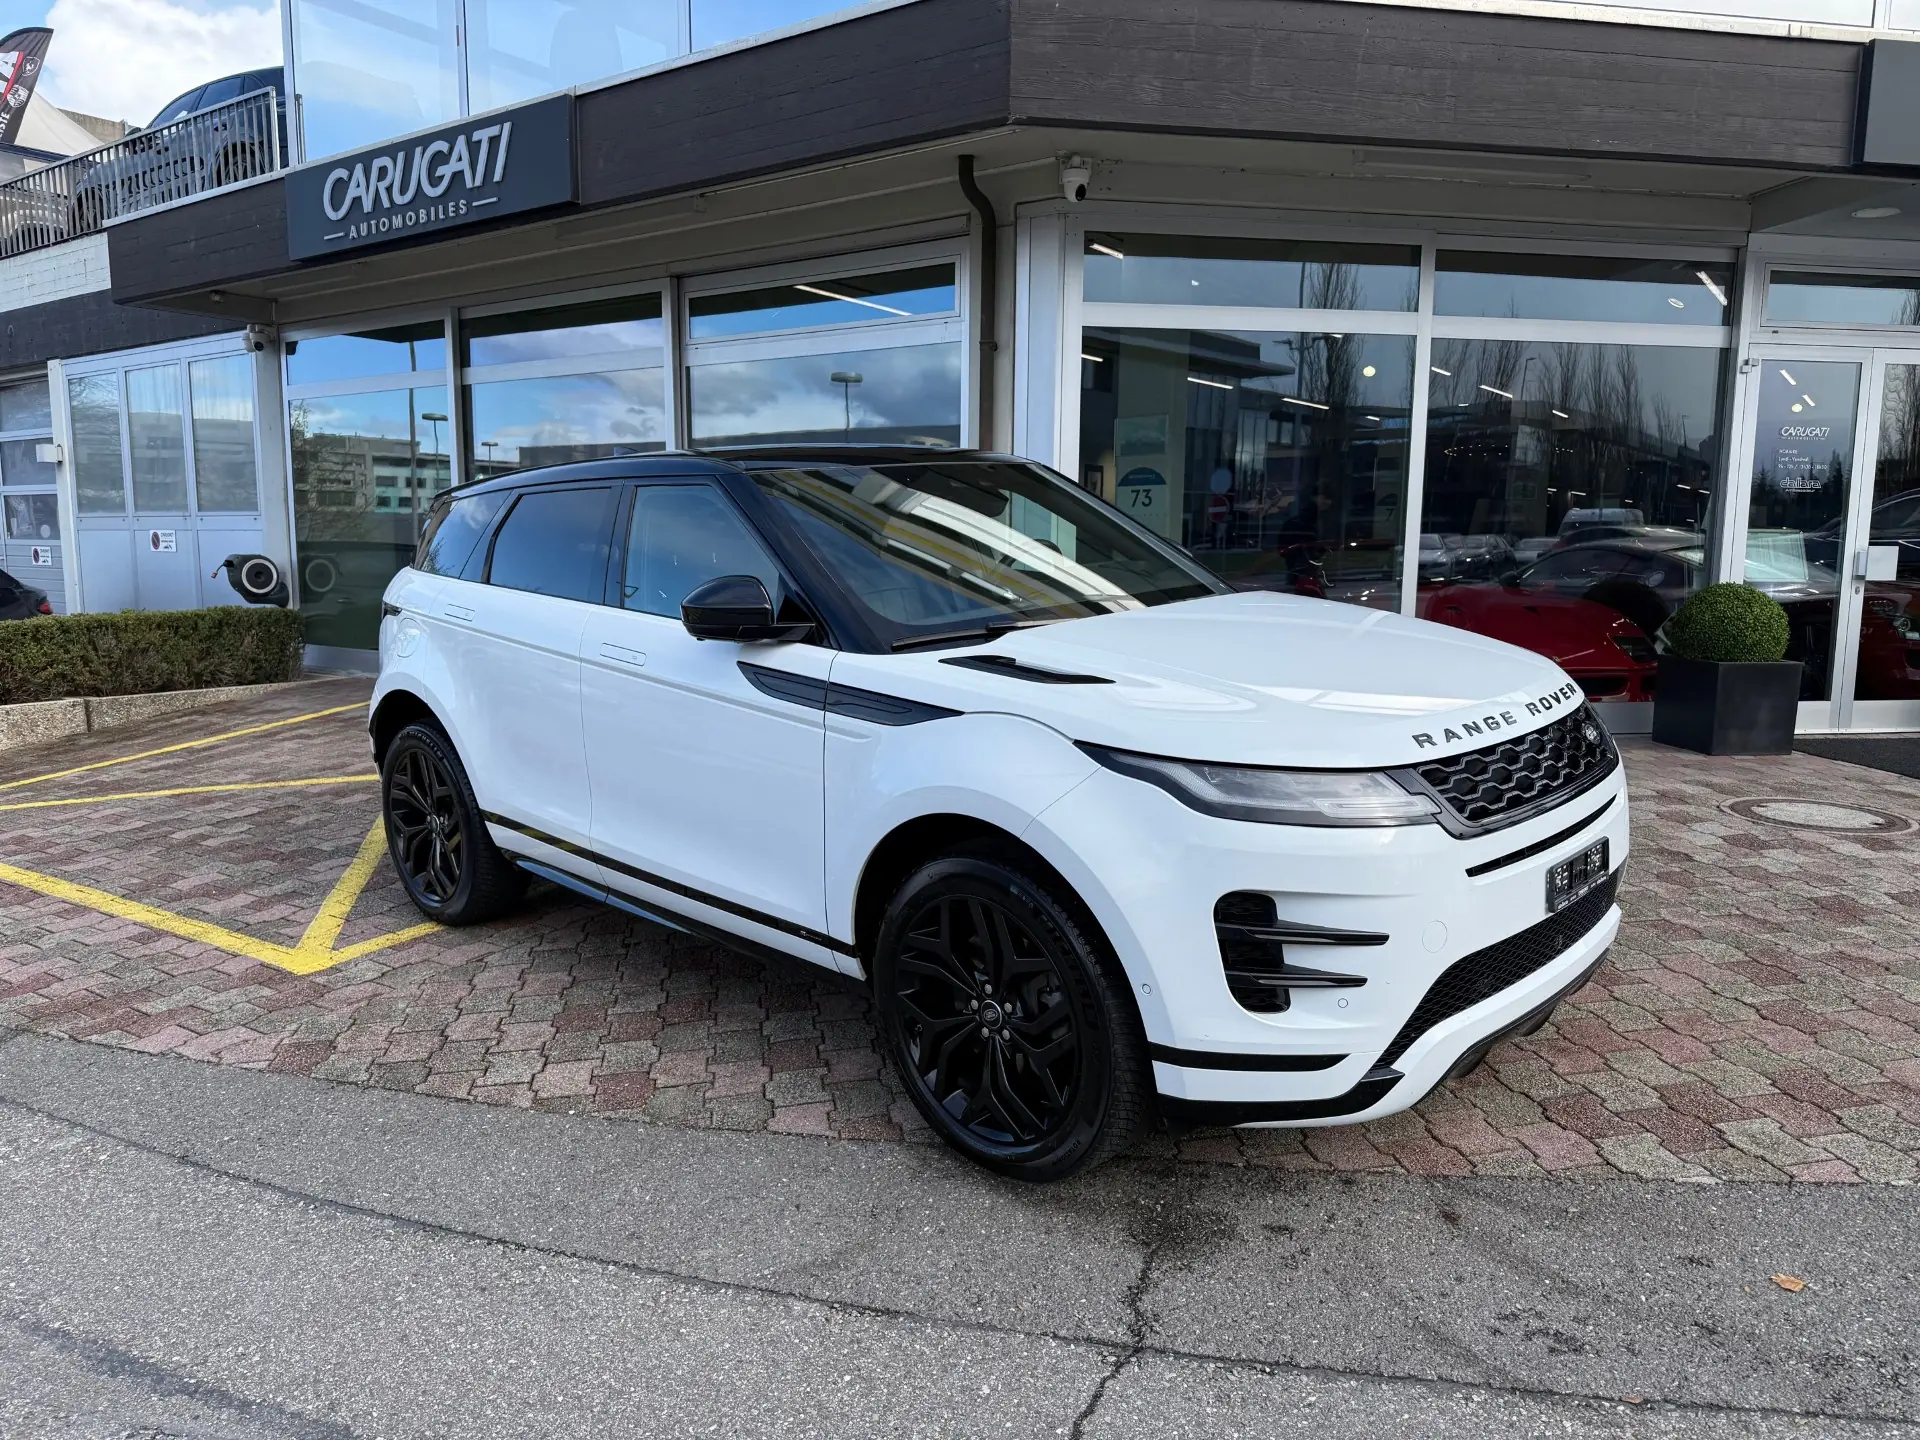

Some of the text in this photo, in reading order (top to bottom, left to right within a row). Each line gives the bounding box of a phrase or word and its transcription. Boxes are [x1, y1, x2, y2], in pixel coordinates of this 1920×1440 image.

[323, 121, 512, 220] CARUGATI
[349, 199, 468, 239] AUTOMOBILES
[1781, 426, 1830, 437] CARUGATI
[1780, 476, 1822, 489] dallara
[1130, 488, 1153, 508] 73
[1411, 682, 1577, 749] RANGE ROVER
